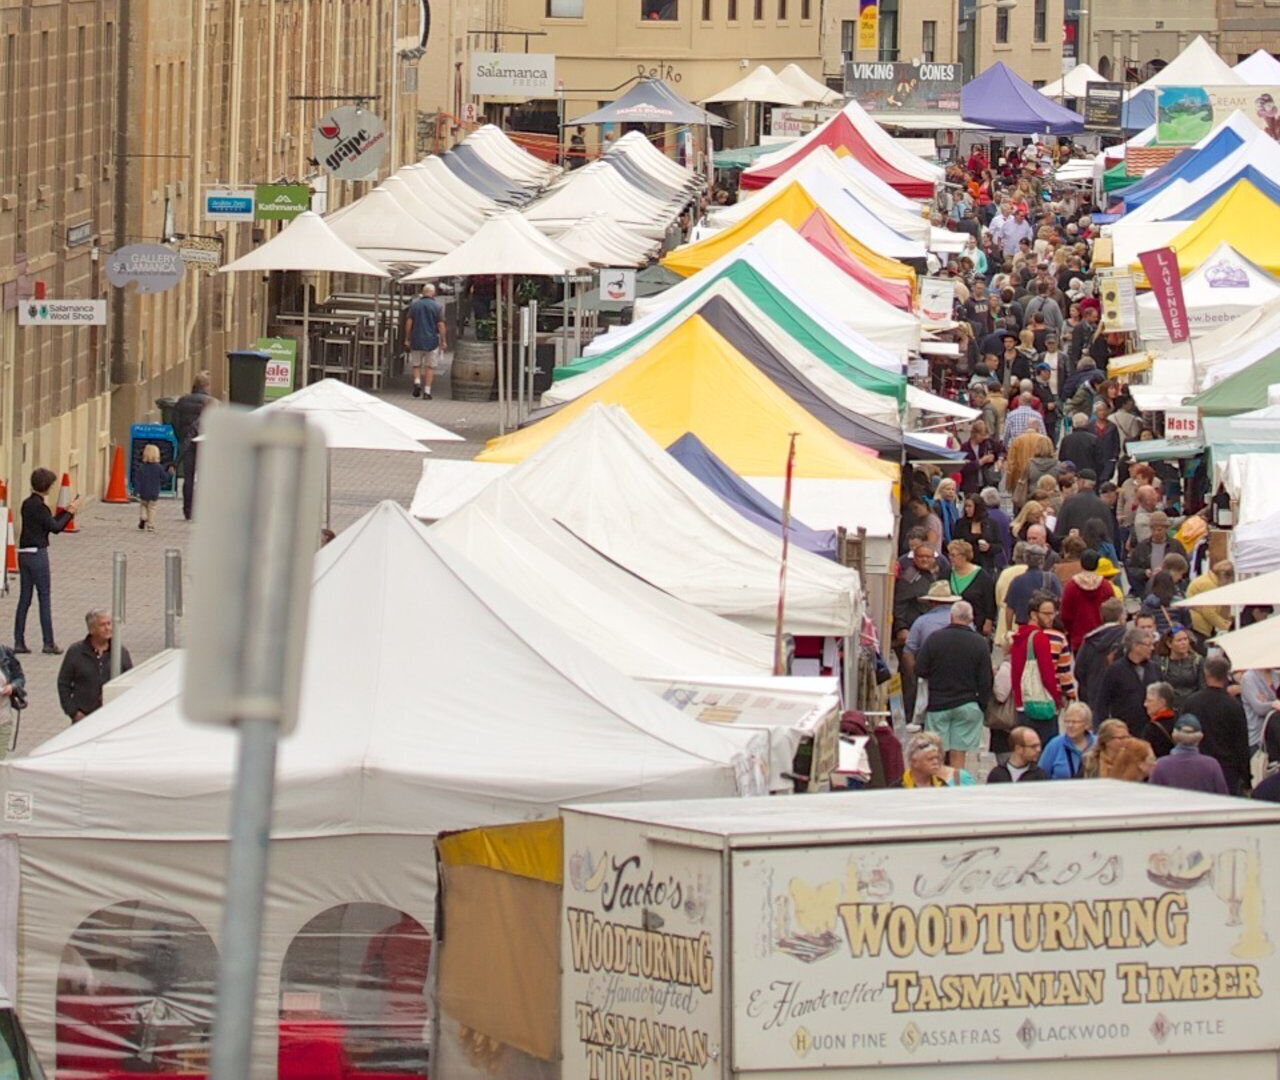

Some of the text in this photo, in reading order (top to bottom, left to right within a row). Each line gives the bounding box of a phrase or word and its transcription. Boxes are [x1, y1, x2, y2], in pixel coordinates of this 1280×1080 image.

[476, 65, 548, 80] Salamanca
[513, 78, 546, 87] FRESH
[852, 64, 954, 81] VIKING CONES
[1208, 94, 1247, 106] CREAM
[773, 121, 800, 132] CREAM
[326, 129, 369, 170] grape
[112, 262, 176, 272] SALAMANCA
[131, 254, 176, 262] GALLERY
[1157, 254, 1182, 338] LAVENDER
[49, 304, 94, 312] Salamanca
[72, 313, 94, 321] Shop
[266, 365, 288, 376] ale
[1168, 418, 1195, 430] Hats
[602, 855, 682, 910] Jacko's
[914, 846, 1120, 898] Jacko's
[839, 892, 1189, 958] WOODTURNING
[567, 906, 713, 994] WOODTURNING
[599, 975, 700, 1015] Handcrafted
[763, 980, 885, 1030] Handcrafted
[886, 970, 1104, 1012] TASMANIAN
[1118, 962, 1262, 1003] TIMBER
[576, 1001, 708, 1068] TASMANIAN
[792, 1026, 887, 1052] HUON PINE
[1021, 1023, 1130, 1045] BLACKWOOD
[1154, 1018, 1225, 1039] MYRTLE
[906, 1028, 1001, 1051] SASSAFRAS
